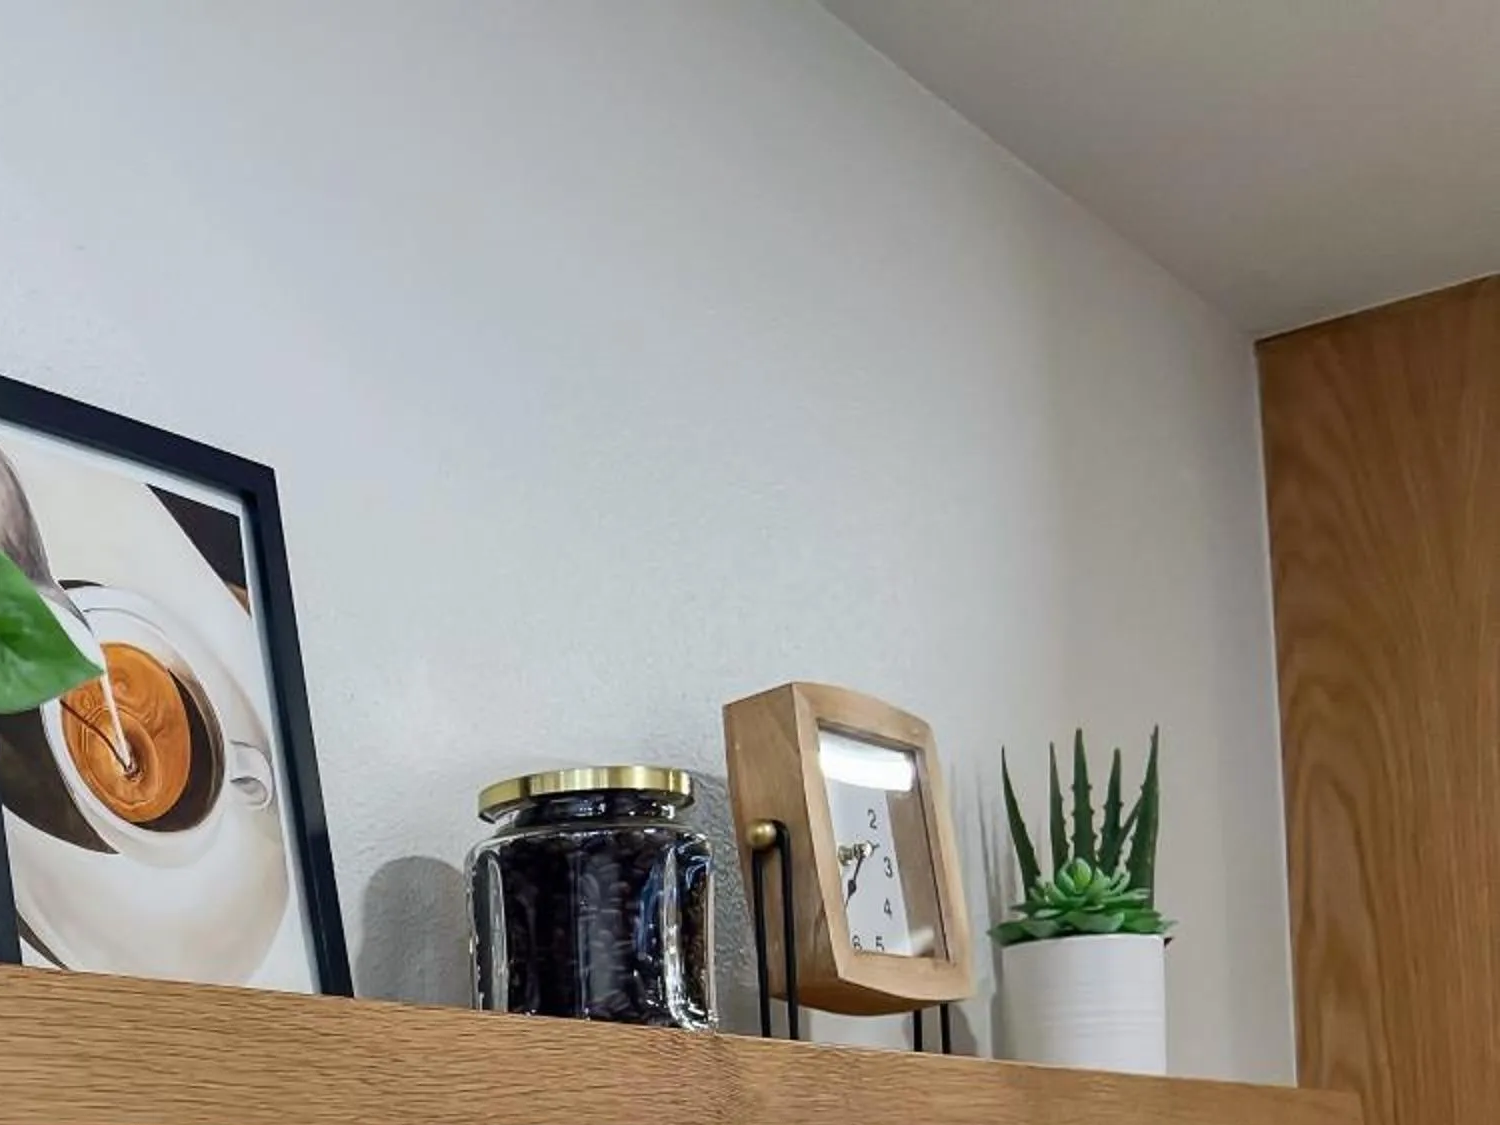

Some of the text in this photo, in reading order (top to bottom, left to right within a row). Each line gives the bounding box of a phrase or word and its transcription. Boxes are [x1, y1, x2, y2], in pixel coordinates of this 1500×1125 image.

[867, 809, 877, 829] 2
[884, 857, 893, 878] 3
[883, 899, 892, 918] 4
